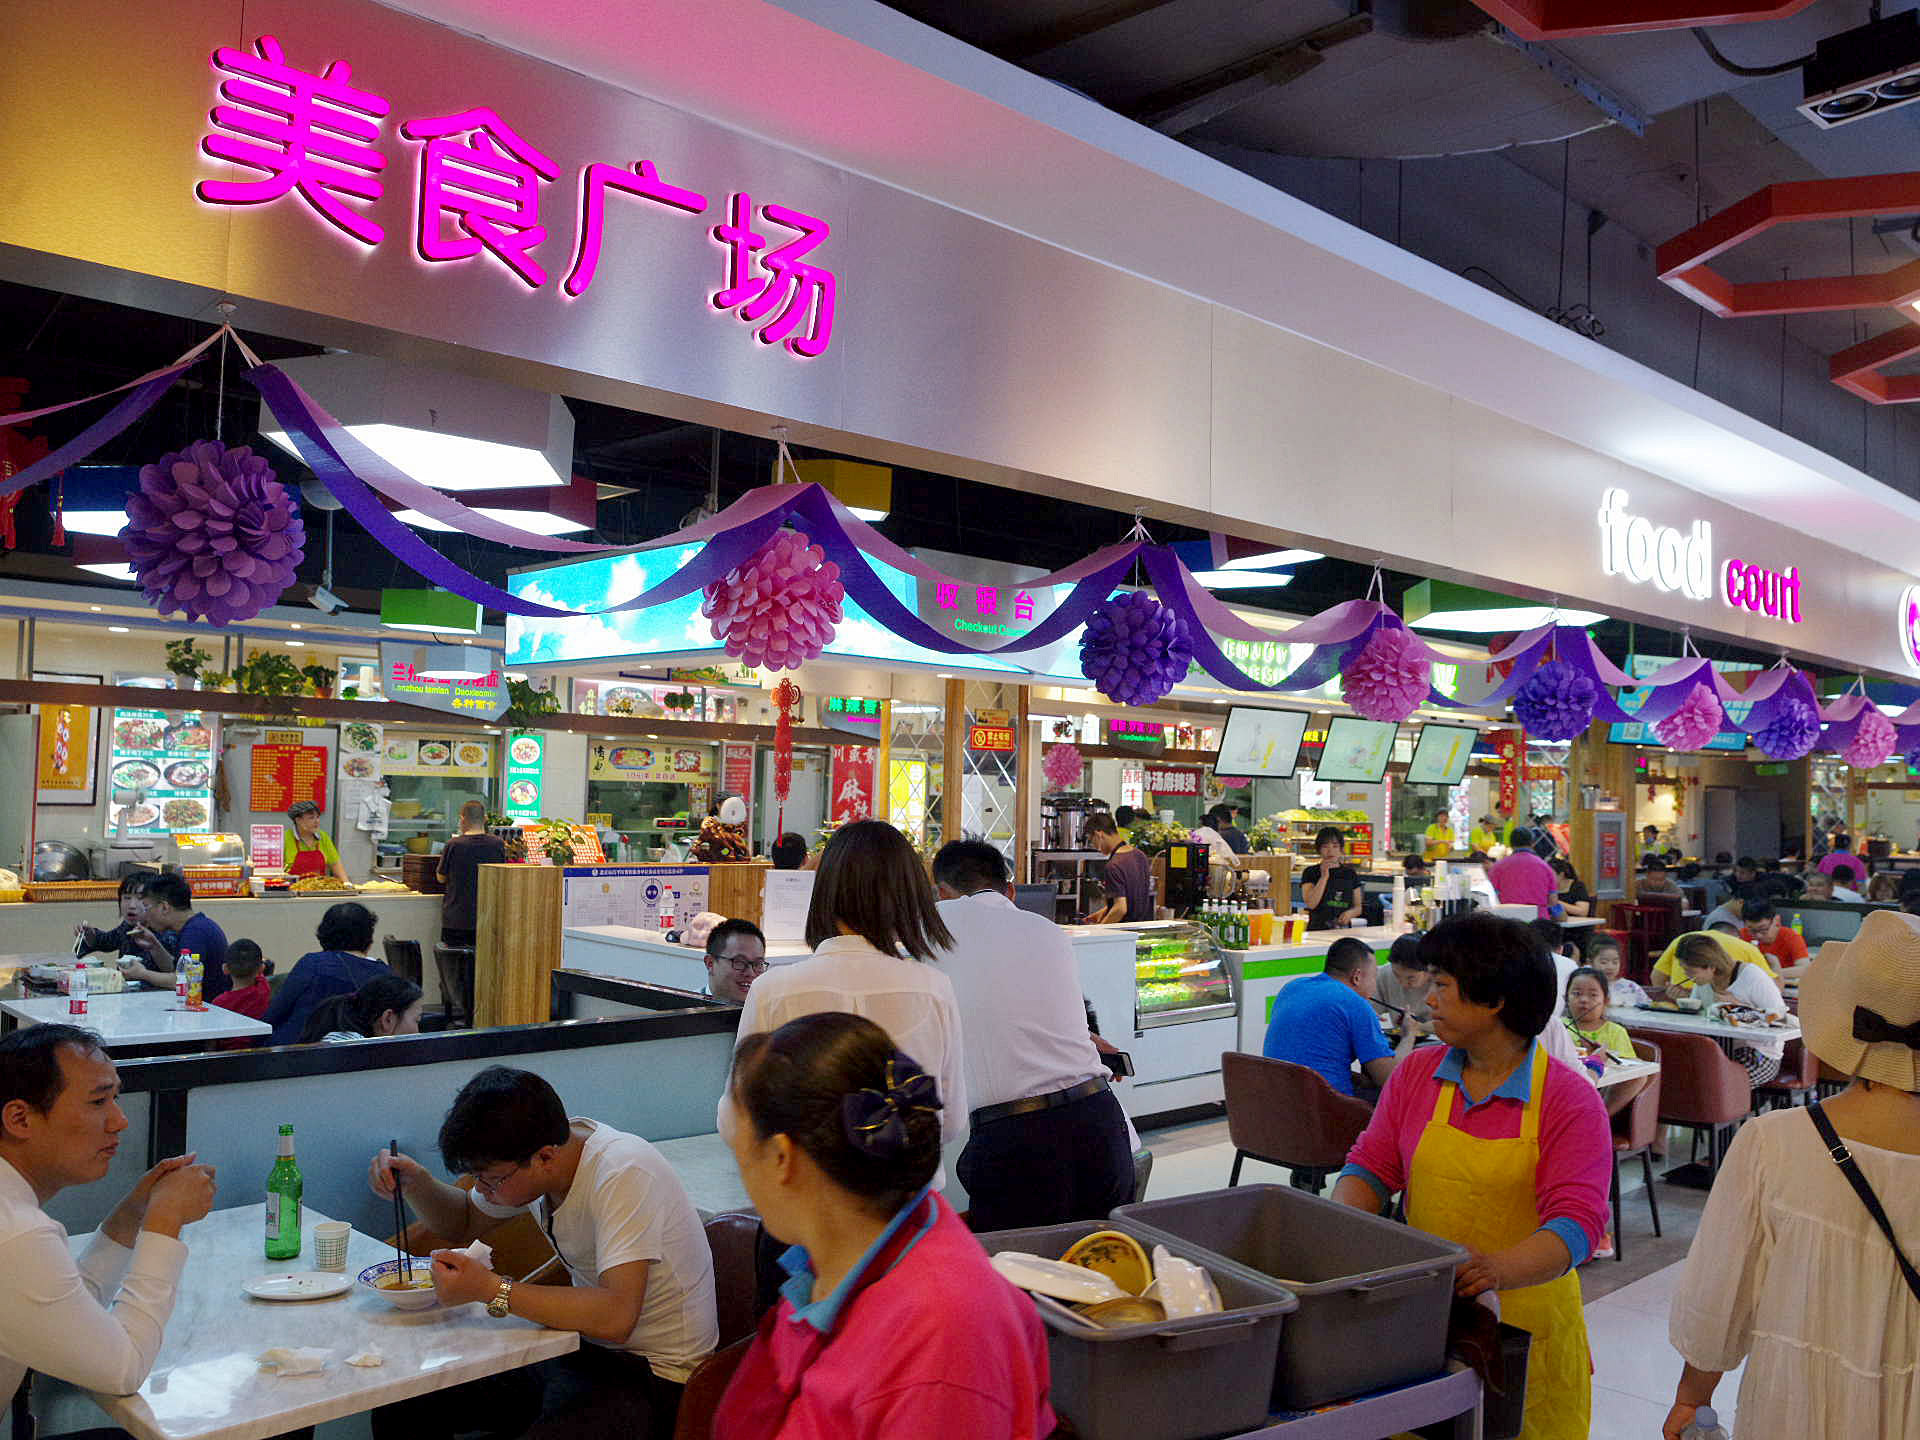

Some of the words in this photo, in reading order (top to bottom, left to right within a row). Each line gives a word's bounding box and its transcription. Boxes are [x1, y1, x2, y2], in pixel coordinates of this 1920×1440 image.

[196, 36, 838, 358] 美食广场
[935, 582, 1037, 622] 收银台
[1600, 488, 1712, 600] food
[1721, 558, 1803, 624] court
